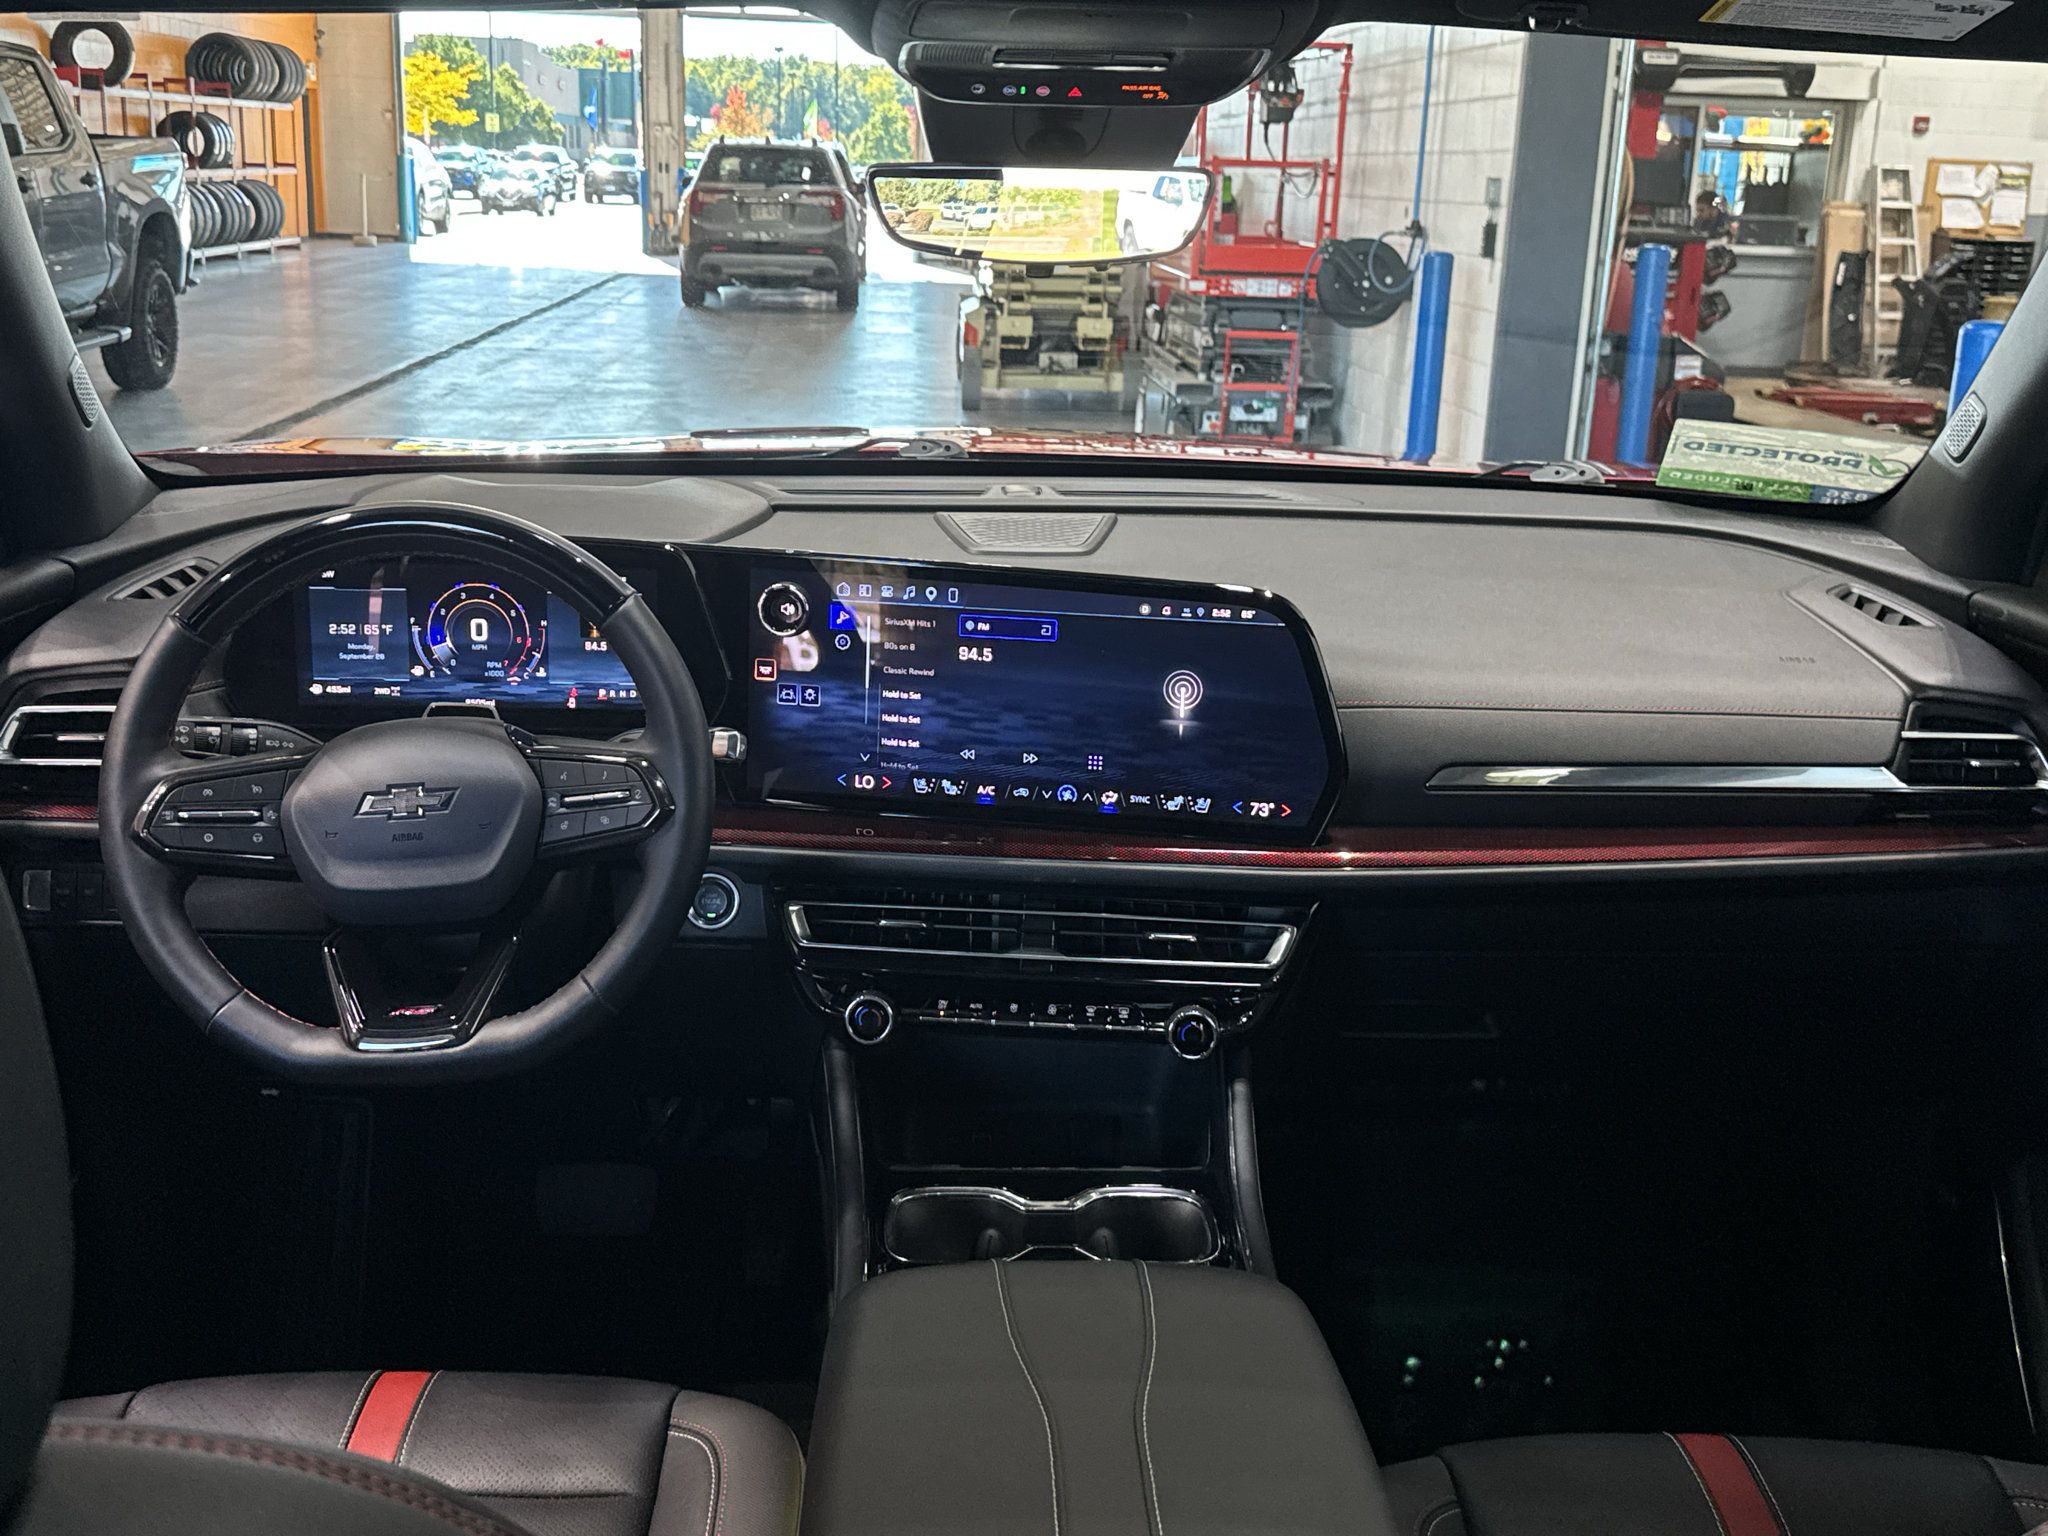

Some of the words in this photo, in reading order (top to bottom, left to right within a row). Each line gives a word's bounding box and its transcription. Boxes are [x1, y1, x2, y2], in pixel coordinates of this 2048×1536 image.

[916, 620, 931, 628] Hits
[977, 622, 990, 631] FM
[328, 623, 356, 635] 2:52
[364, 624, 380, 636] 65
[381, 624, 394, 636] °F
[469, 618, 489, 642] 0
[472, 643, 488, 651] MPH
[899, 643, 909, 651] on
[339, 652, 374, 662] September
[959, 646, 993, 662] 94.5
[487, 661, 502, 669] RPM
[883, 665, 907, 675] Classic
[909, 667, 935, 677] Rewind
[598, 688, 607, 697] P
[609, 690, 616, 698] R
[619, 690, 627, 698] N
[629, 690, 637, 698] D
[882, 690, 900, 699] Hold
[900, 691, 909, 699] to
[909, 692, 922, 700] Set
[882, 714, 900, 723] Hold
[900, 715, 909, 723] to
[909, 716, 922, 724] Set
[881, 738, 899, 747] Hold
[899, 739, 908, 747] to
[908, 740, 921, 748] Set
[854, 774, 875, 789] LO
[976, 785, 996, 796] A/C
[1129, 795, 1151, 804] SYNC
[1250, 802, 1276, 817] 73°
[391, 831, 425, 842] AIRBAG
